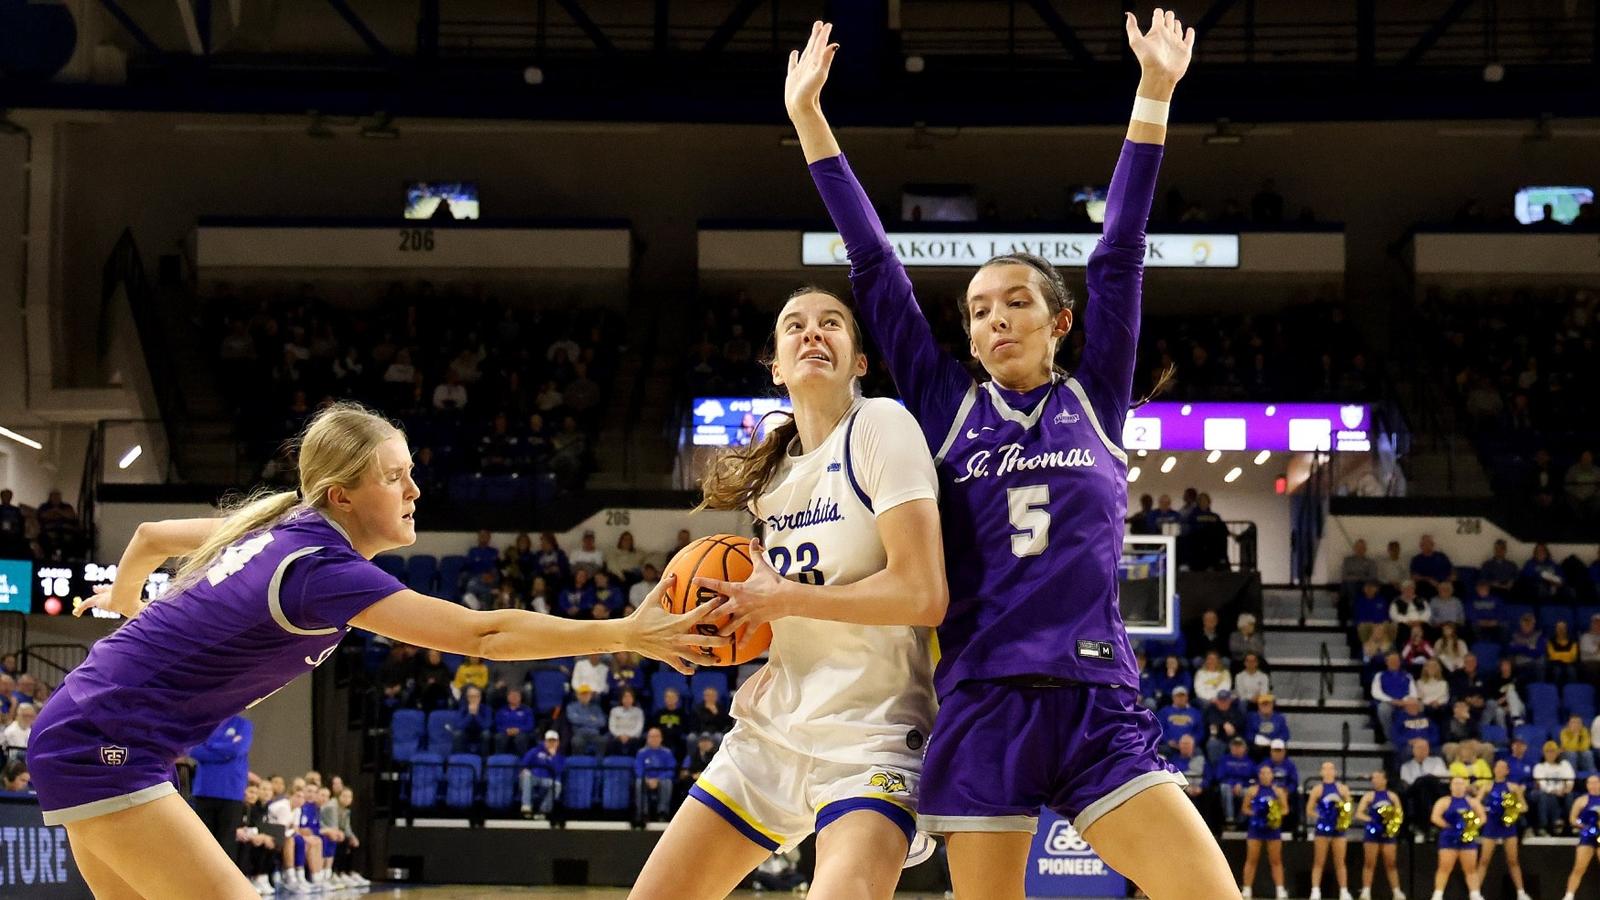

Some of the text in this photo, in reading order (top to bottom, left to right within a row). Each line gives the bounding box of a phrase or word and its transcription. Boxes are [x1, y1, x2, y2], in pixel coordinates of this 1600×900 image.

[399, 230, 434, 251] 206
[896, 241, 976, 258] AKOTA
[1135, 426, 1147, 442] 2
[996, 443, 1096, 477] Thomas
[1006, 484, 1051, 558] 5
[767, 542, 825, 585] 23
[1103, 647, 1109, 655] M
[0, 827, 68, 885] TURE
[1037, 857, 1104, 876] PIONEER
